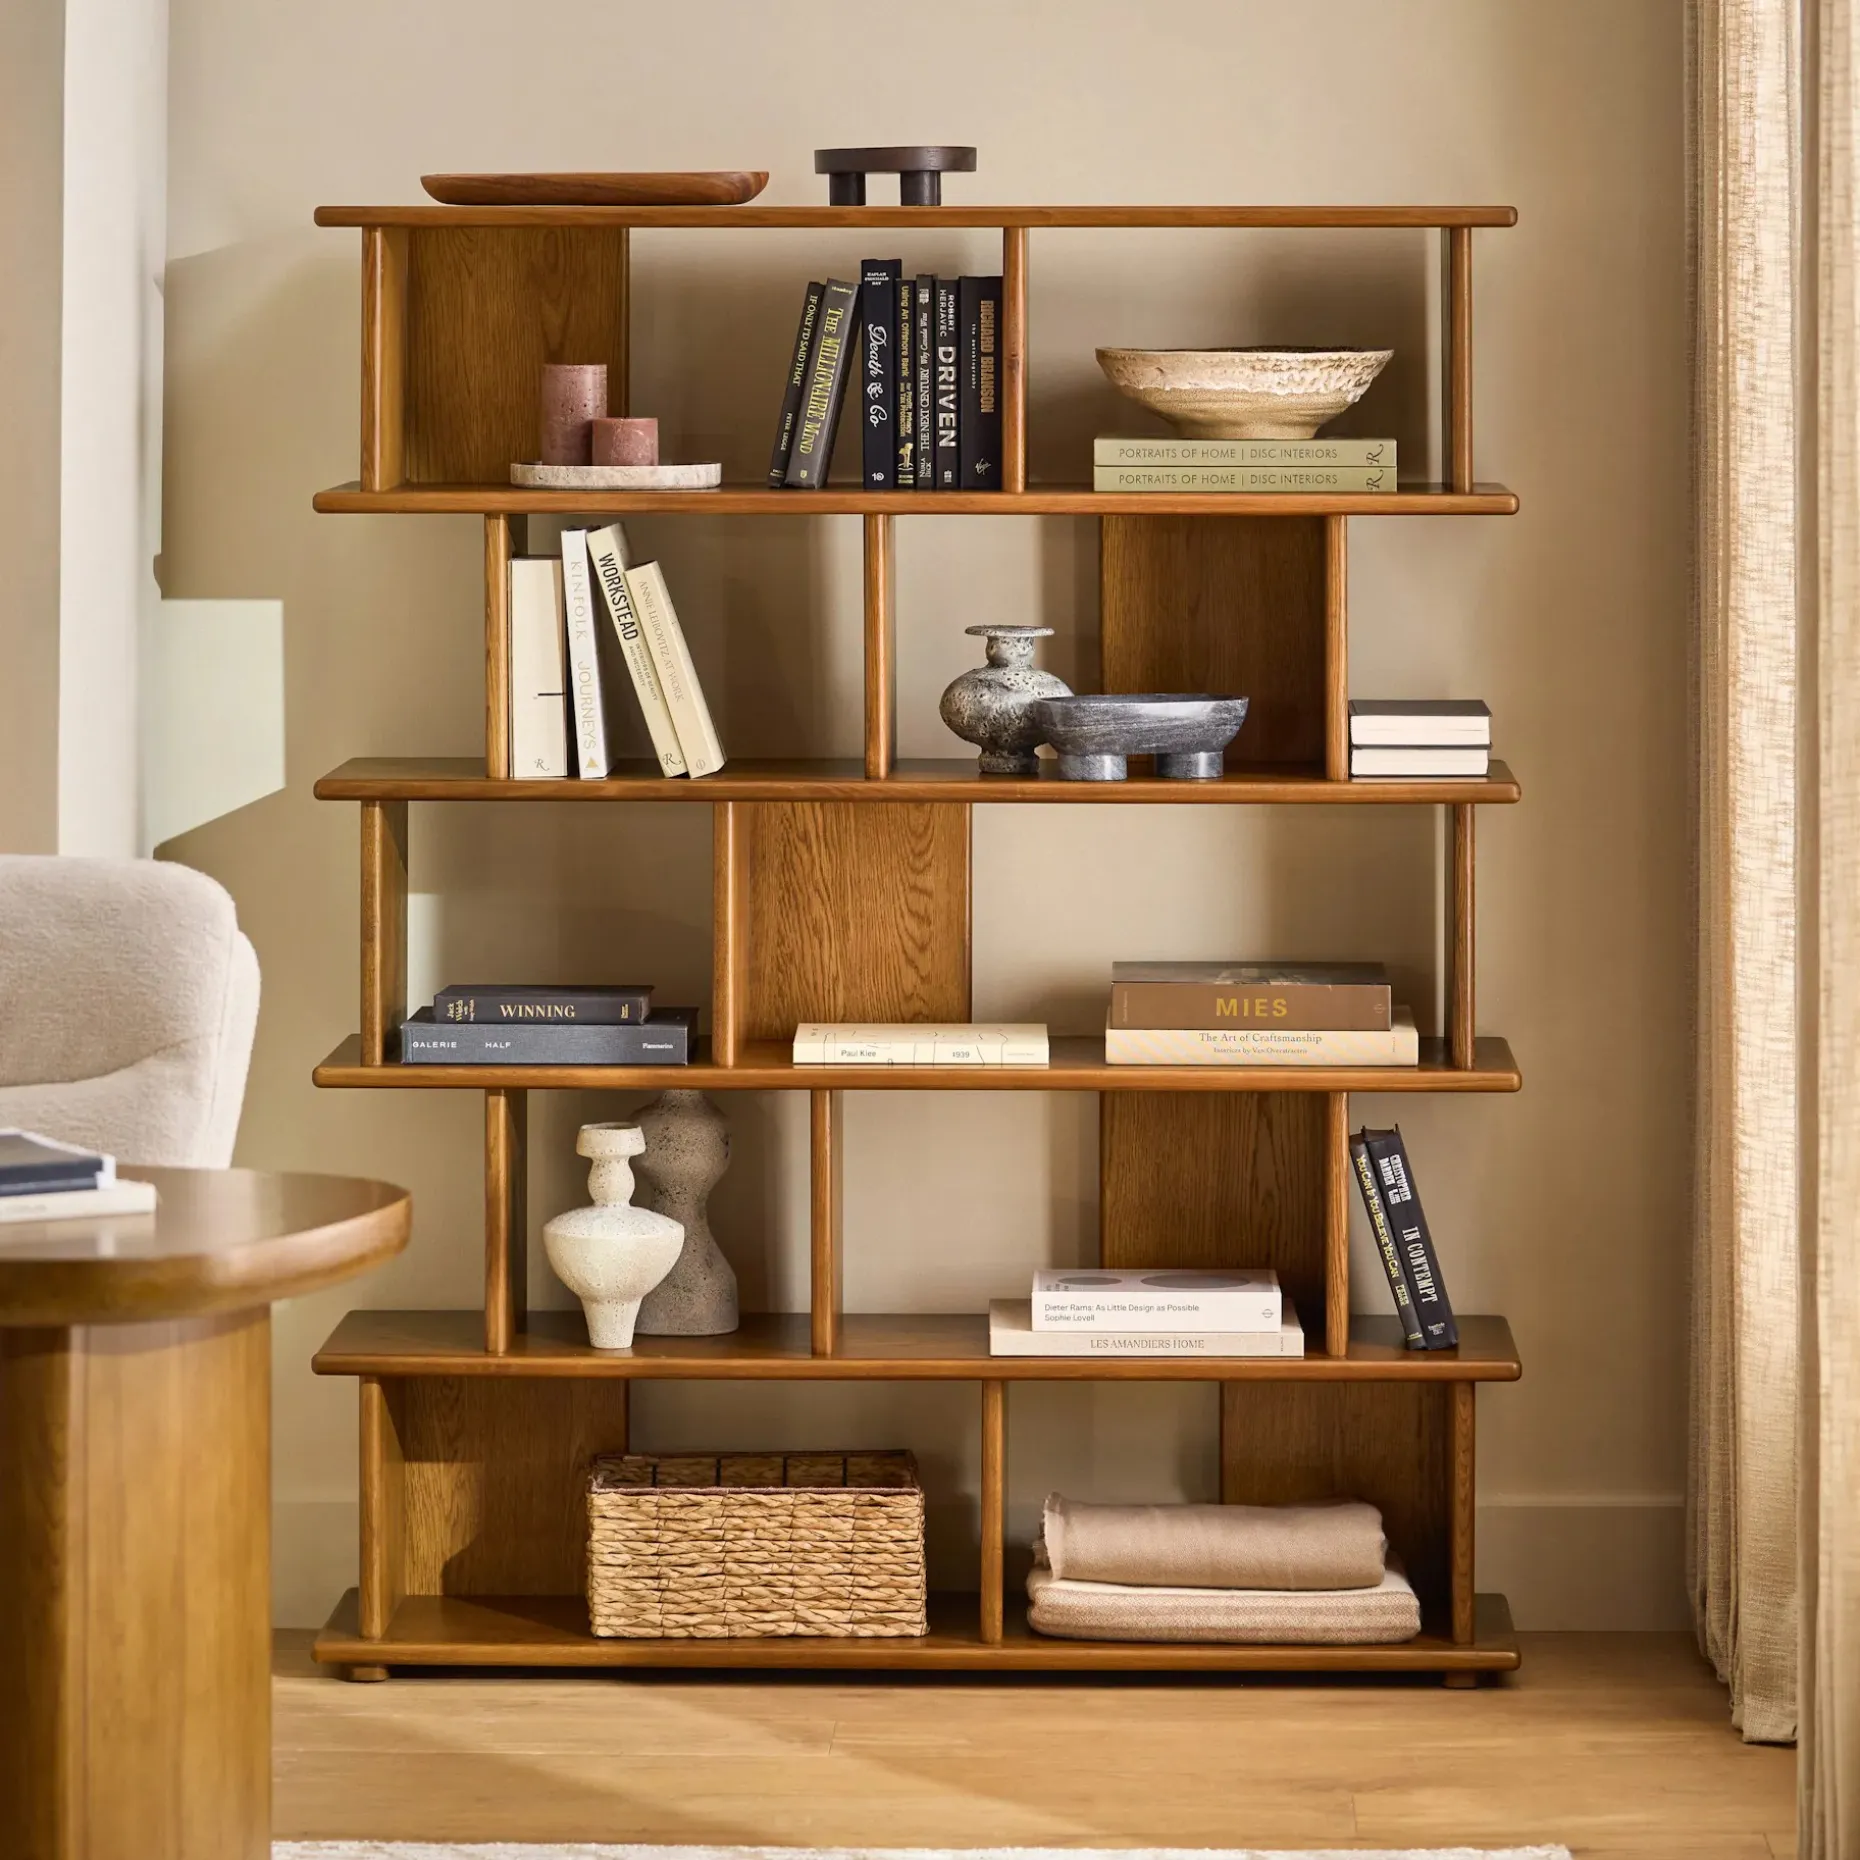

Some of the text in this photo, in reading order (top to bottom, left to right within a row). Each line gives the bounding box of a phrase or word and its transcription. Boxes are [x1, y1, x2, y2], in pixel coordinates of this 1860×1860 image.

[809, 295, 818, 304] IF
[804, 304, 816, 329] ONLY
[901, 286, 909, 377] Using An Offshore Bank
[920, 328, 928, 350] Canada
[797, 341, 808, 361] SAID
[920, 352, 930, 365] Why
[981, 300, 994, 413] RICHARD BRANSON
[793, 362, 805, 387] THAT
[799, 307, 844, 454] THE MILLIONAIRE MIND
[867, 323, 888, 428] Death & Co
[938, 347, 956, 447] DRIVEN
[920, 367, 930, 451] THE NEXT CENTURY
[1119, 449, 1338, 458] PORTRAITS OF HOME DISC INTERIORS
[1119, 474, 1338, 484] PORTRAITS OF HOME DISC INTERIORS
[598, 552, 639, 641] WORKSTEAD
[639, 581, 684, 702] ANNIE LEIBOVITZ AT WORK
[570, 561, 596, 749] KINFOLK JOURNEYS
[500, 1005, 575, 1018] WINNING
[1216, 998, 1287, 1017] MIES
[412, 1041, 457, 1049] GALERIE
[1199, 1033, 1322, 1044] The Art of Craftsmanship
[1357, 1154, 1367, 1172] YOU
[1379, 1157, 1395, 1186] DARDEN
[1361, 1172, 1373, 1190] CAN
[1390, 1154, 1411, 1201] CHRISTOPHER
[1370, 1196, 1380, 1213] YOU
[1374, 1213, 1389, 1245] BELIEVE
[1402, 1226, 1420, 1241] IN
[1383, 1242, 1394, 1260] YOU
[1388, 1260, 1399, 1278] CAN
[1407, 1243, 1438, 1303] CONTEMPT
[1128, 1304, 1154, 1313] Design
[1167, 1304, 1200, 1312] Possible
[1090, 1340, 1204, 1349] LES AMANDIERS HOME
